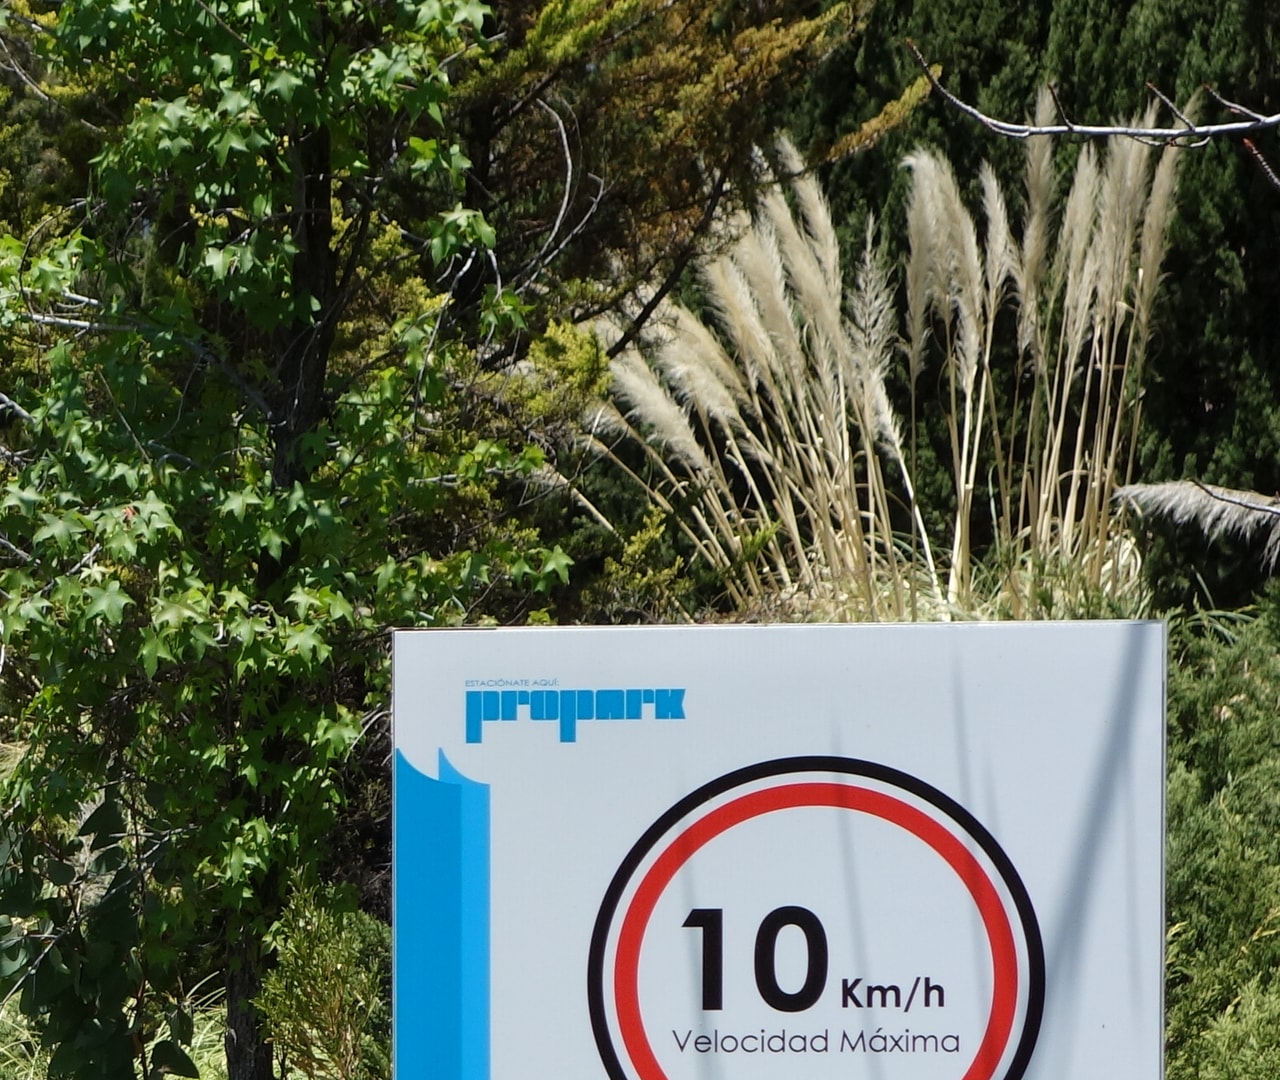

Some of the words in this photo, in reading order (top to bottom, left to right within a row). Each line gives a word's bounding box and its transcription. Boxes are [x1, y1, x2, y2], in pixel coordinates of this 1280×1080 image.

[464, 678, 530, 688] ESTACIÓNATE
[465, 688, 686, 744] propark
[681, 905, 828, 1013] 10
[842, 976, 946, 1013] Km/h
[672, 1027, 829, 1054] Velocidad
[840, 1027, 960, 1053] Máxima
